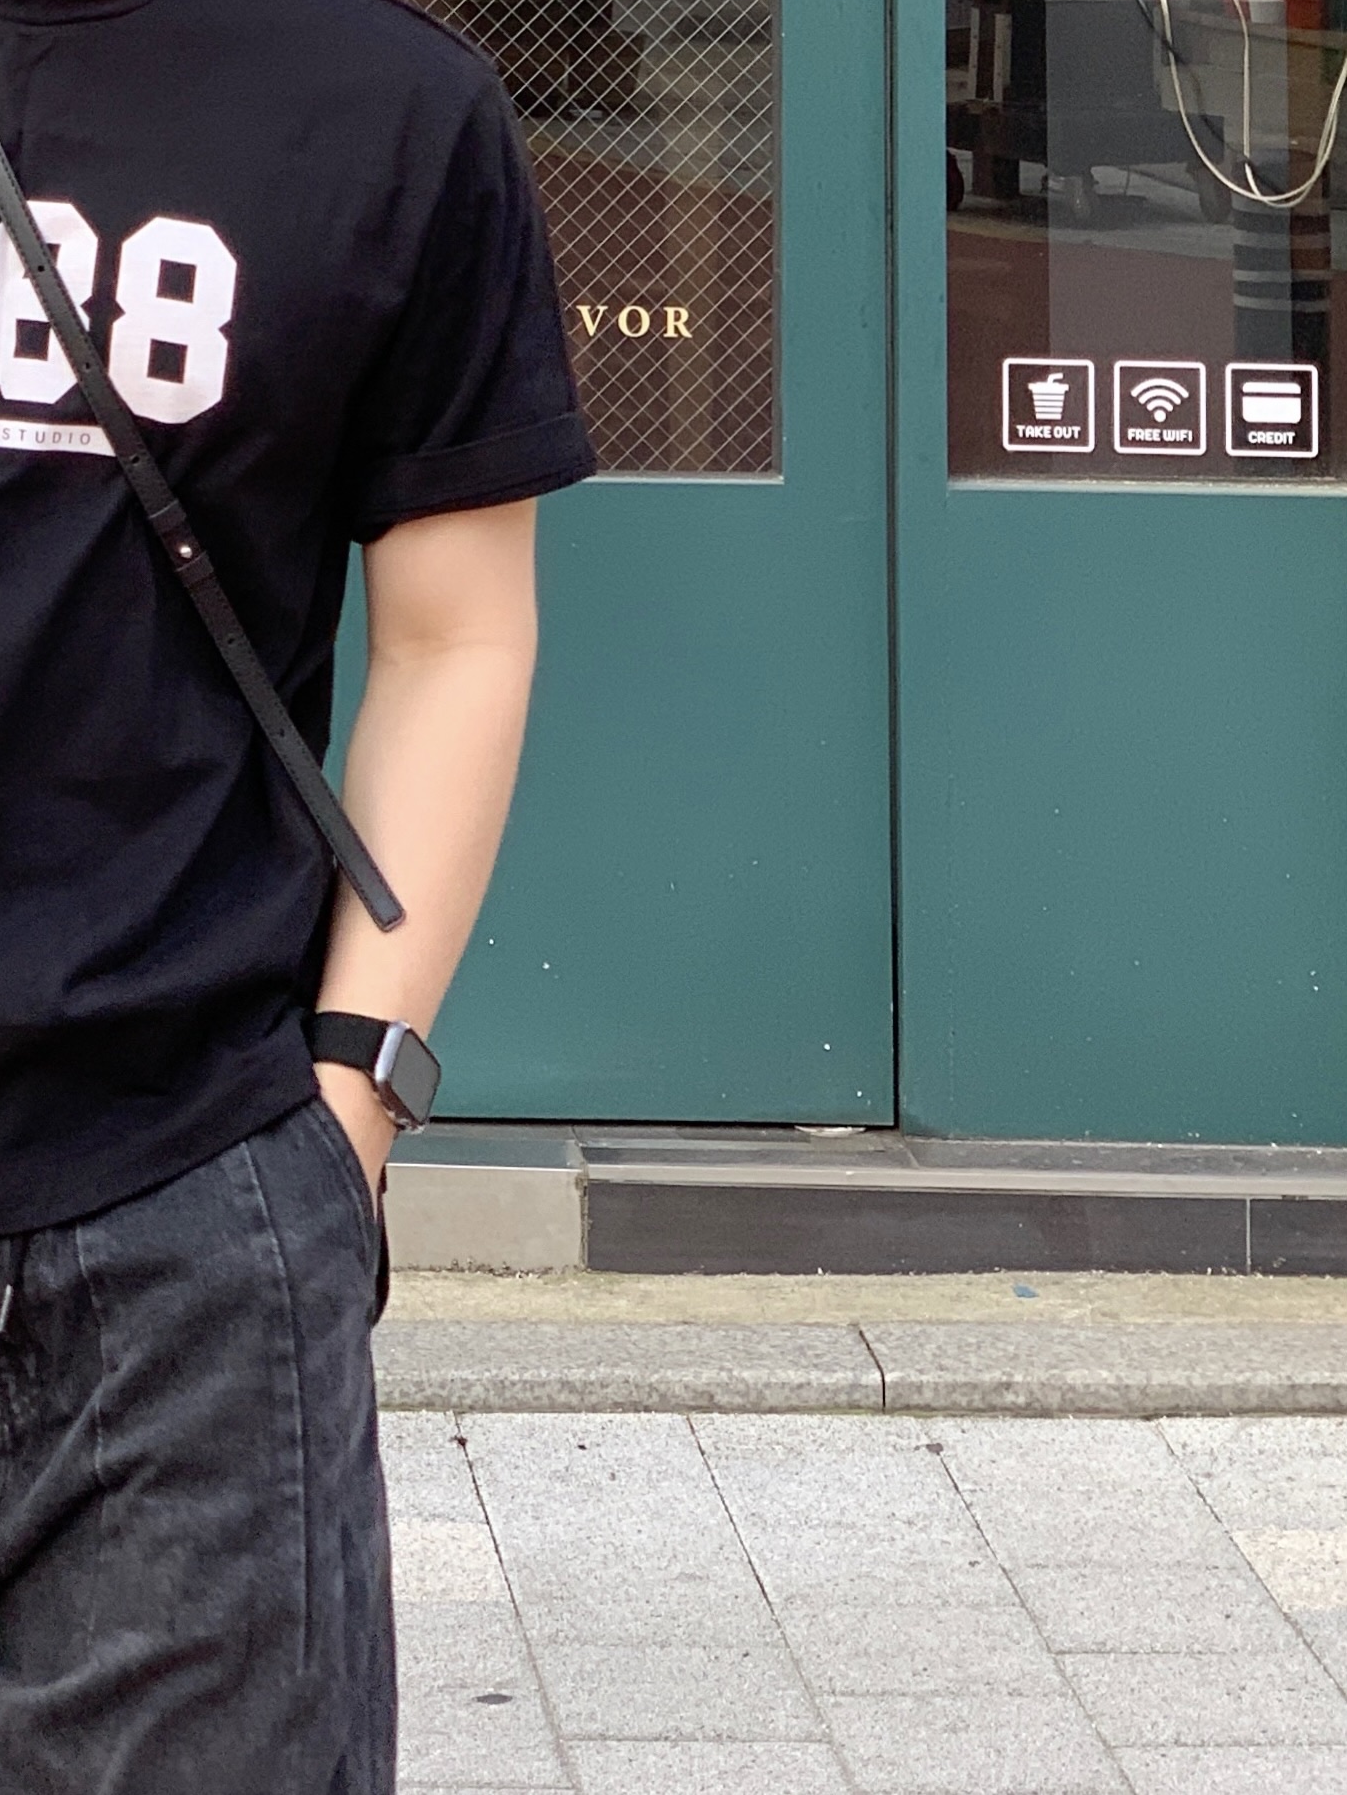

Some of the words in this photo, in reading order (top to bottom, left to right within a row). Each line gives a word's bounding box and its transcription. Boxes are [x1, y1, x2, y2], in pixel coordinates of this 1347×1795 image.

[1016, 424, 1052, 439] TAKE
[1053, 425, 1081, 439] OUT
[1127, 428, 1161, 442] FREE
[1248, 431, 1296, 445] CREDIT
